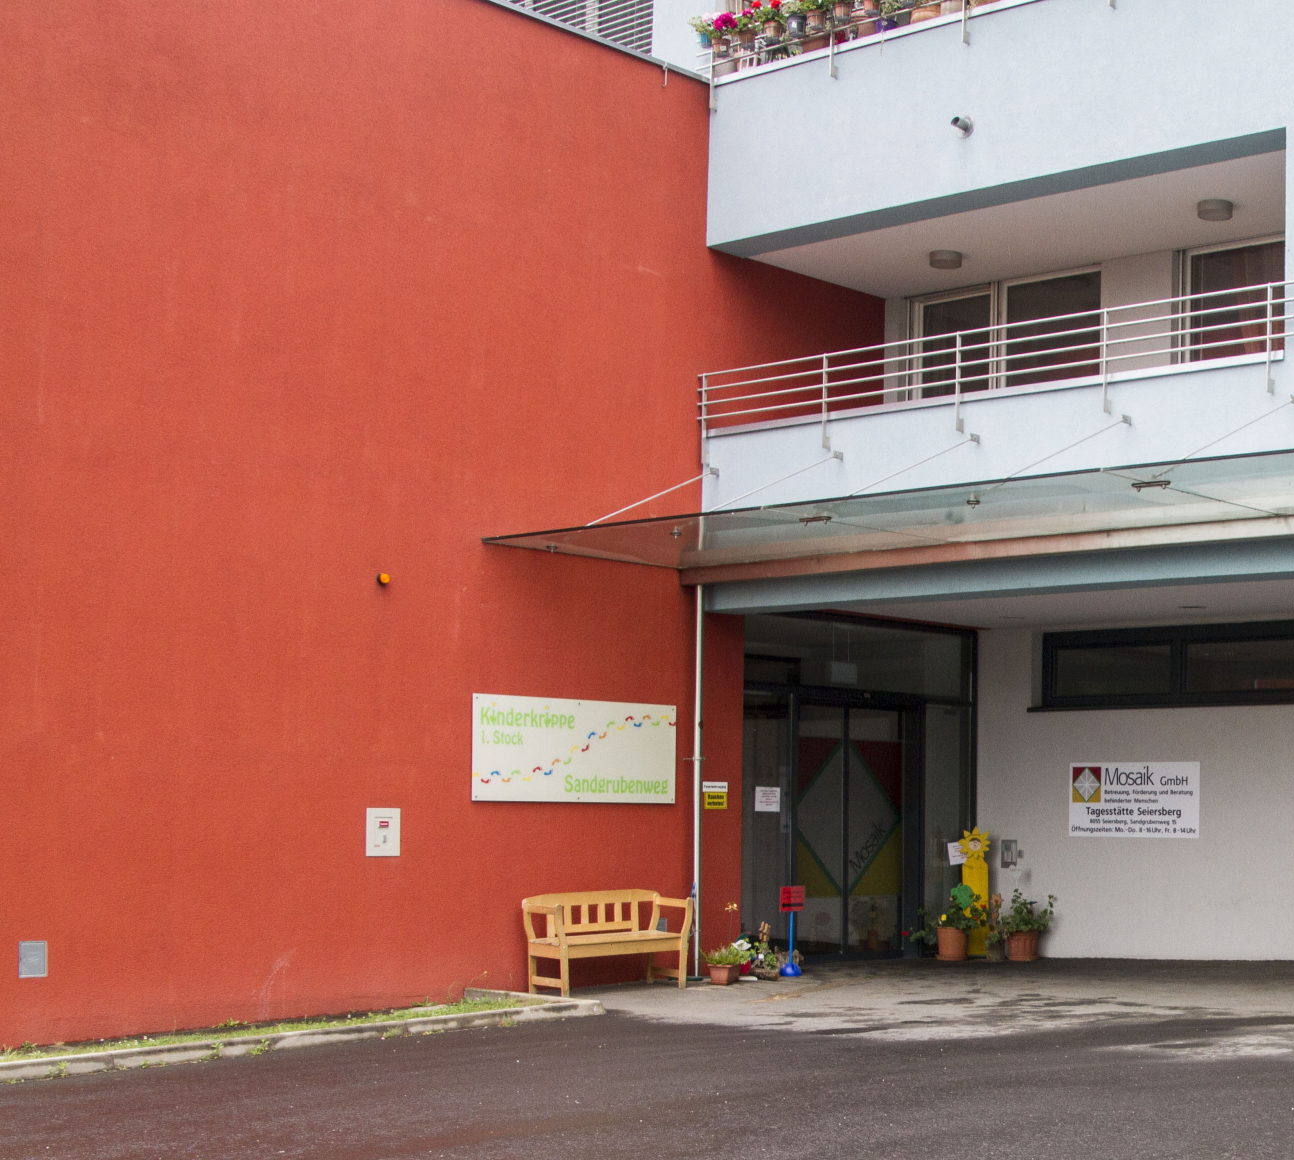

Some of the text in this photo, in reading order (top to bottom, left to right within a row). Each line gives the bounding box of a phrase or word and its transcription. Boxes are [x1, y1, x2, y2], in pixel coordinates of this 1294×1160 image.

[480, 702, 575, 729] Kinderkrippe
[481, 730, 524, 746] 1. Stock
[564, 774, 668, 794] Sandgrubenweg
[1104, 766, 1188, 786] Mosaik GmbH
[1086, 806, 1182, 818] Tagesstätte Seiersberg
[849, 822, 886, 873] Mosaik
